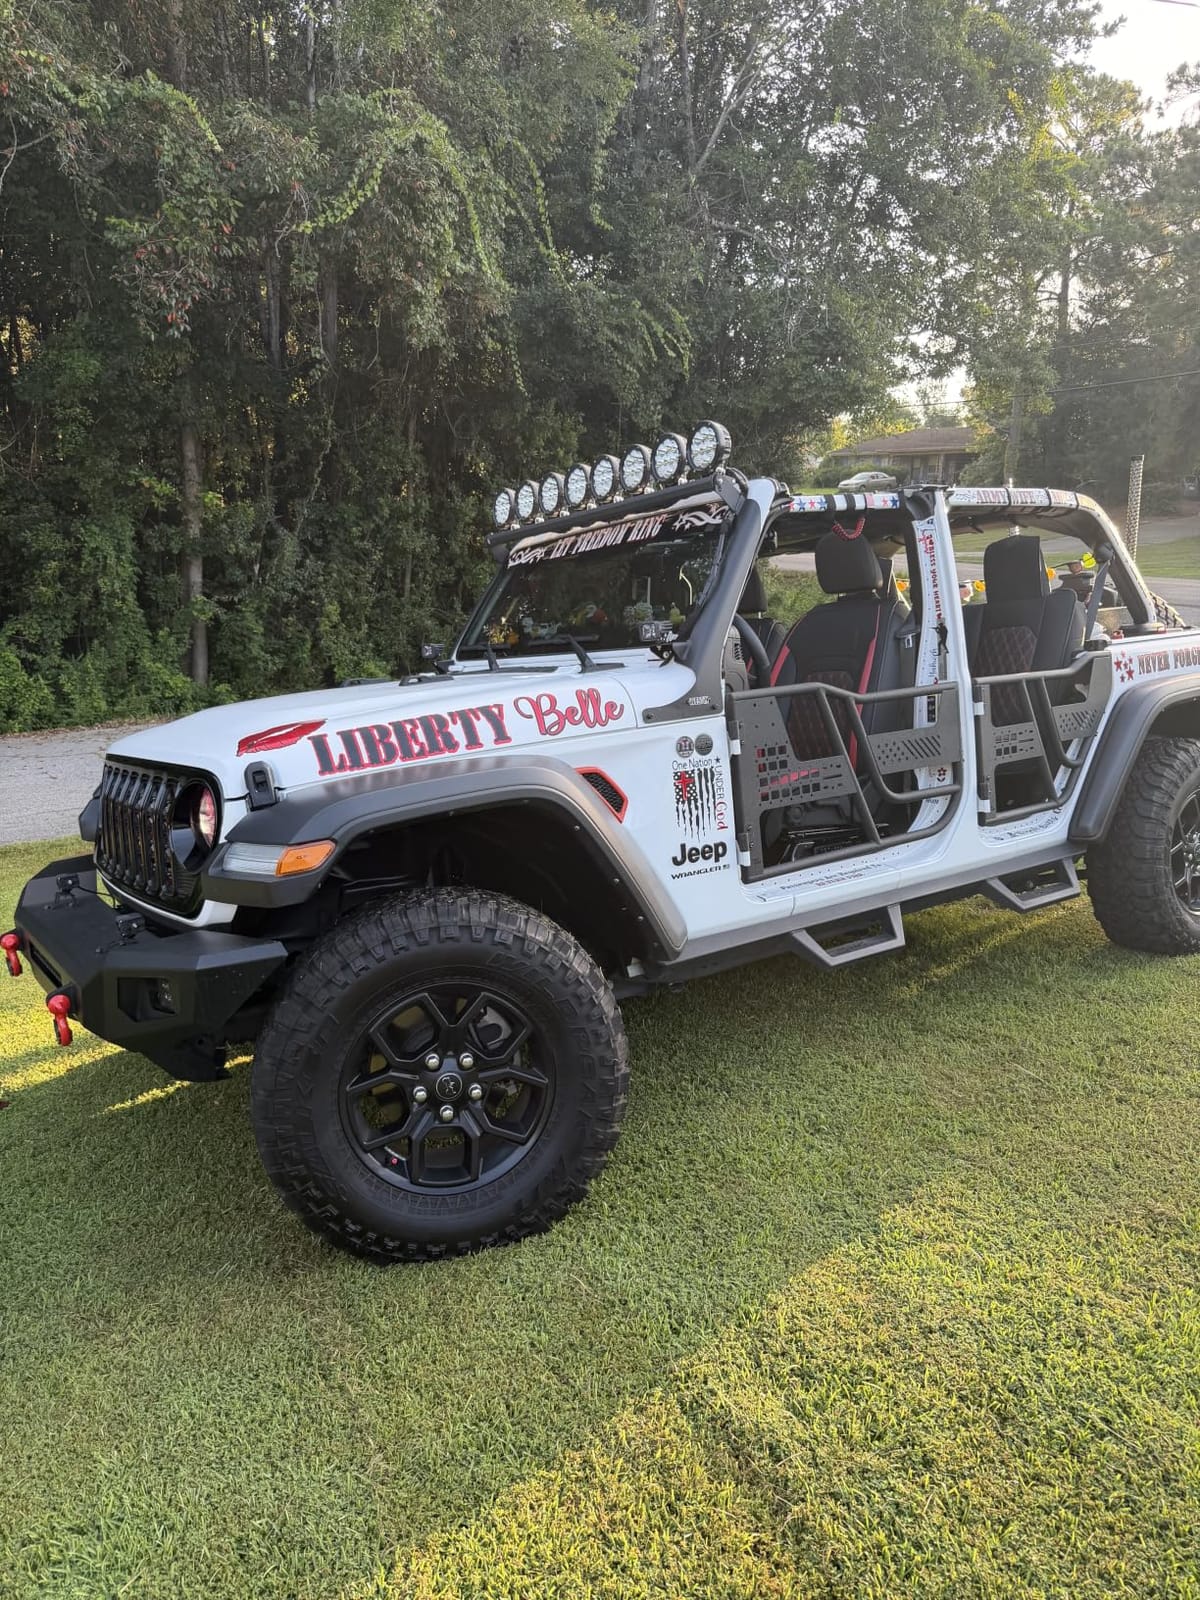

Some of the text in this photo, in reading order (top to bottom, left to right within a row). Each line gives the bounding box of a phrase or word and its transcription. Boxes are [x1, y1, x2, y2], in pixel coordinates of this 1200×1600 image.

[976, 489, 1006, 505] ARMY
[550, 515, 666, 560] LET FREEDOM RING
[1137, 650, 1171, 676] NEVER
[513, 687, 625, 737] Belle
[308, 703, 512, 776] LIBERTY
[672, 757, 713, 771] One Nation
[714, 765, 729, 831] UNDER God
[672, 841, 727, 866] Jeep
[671, 865, 721, 880] WRANGLER
